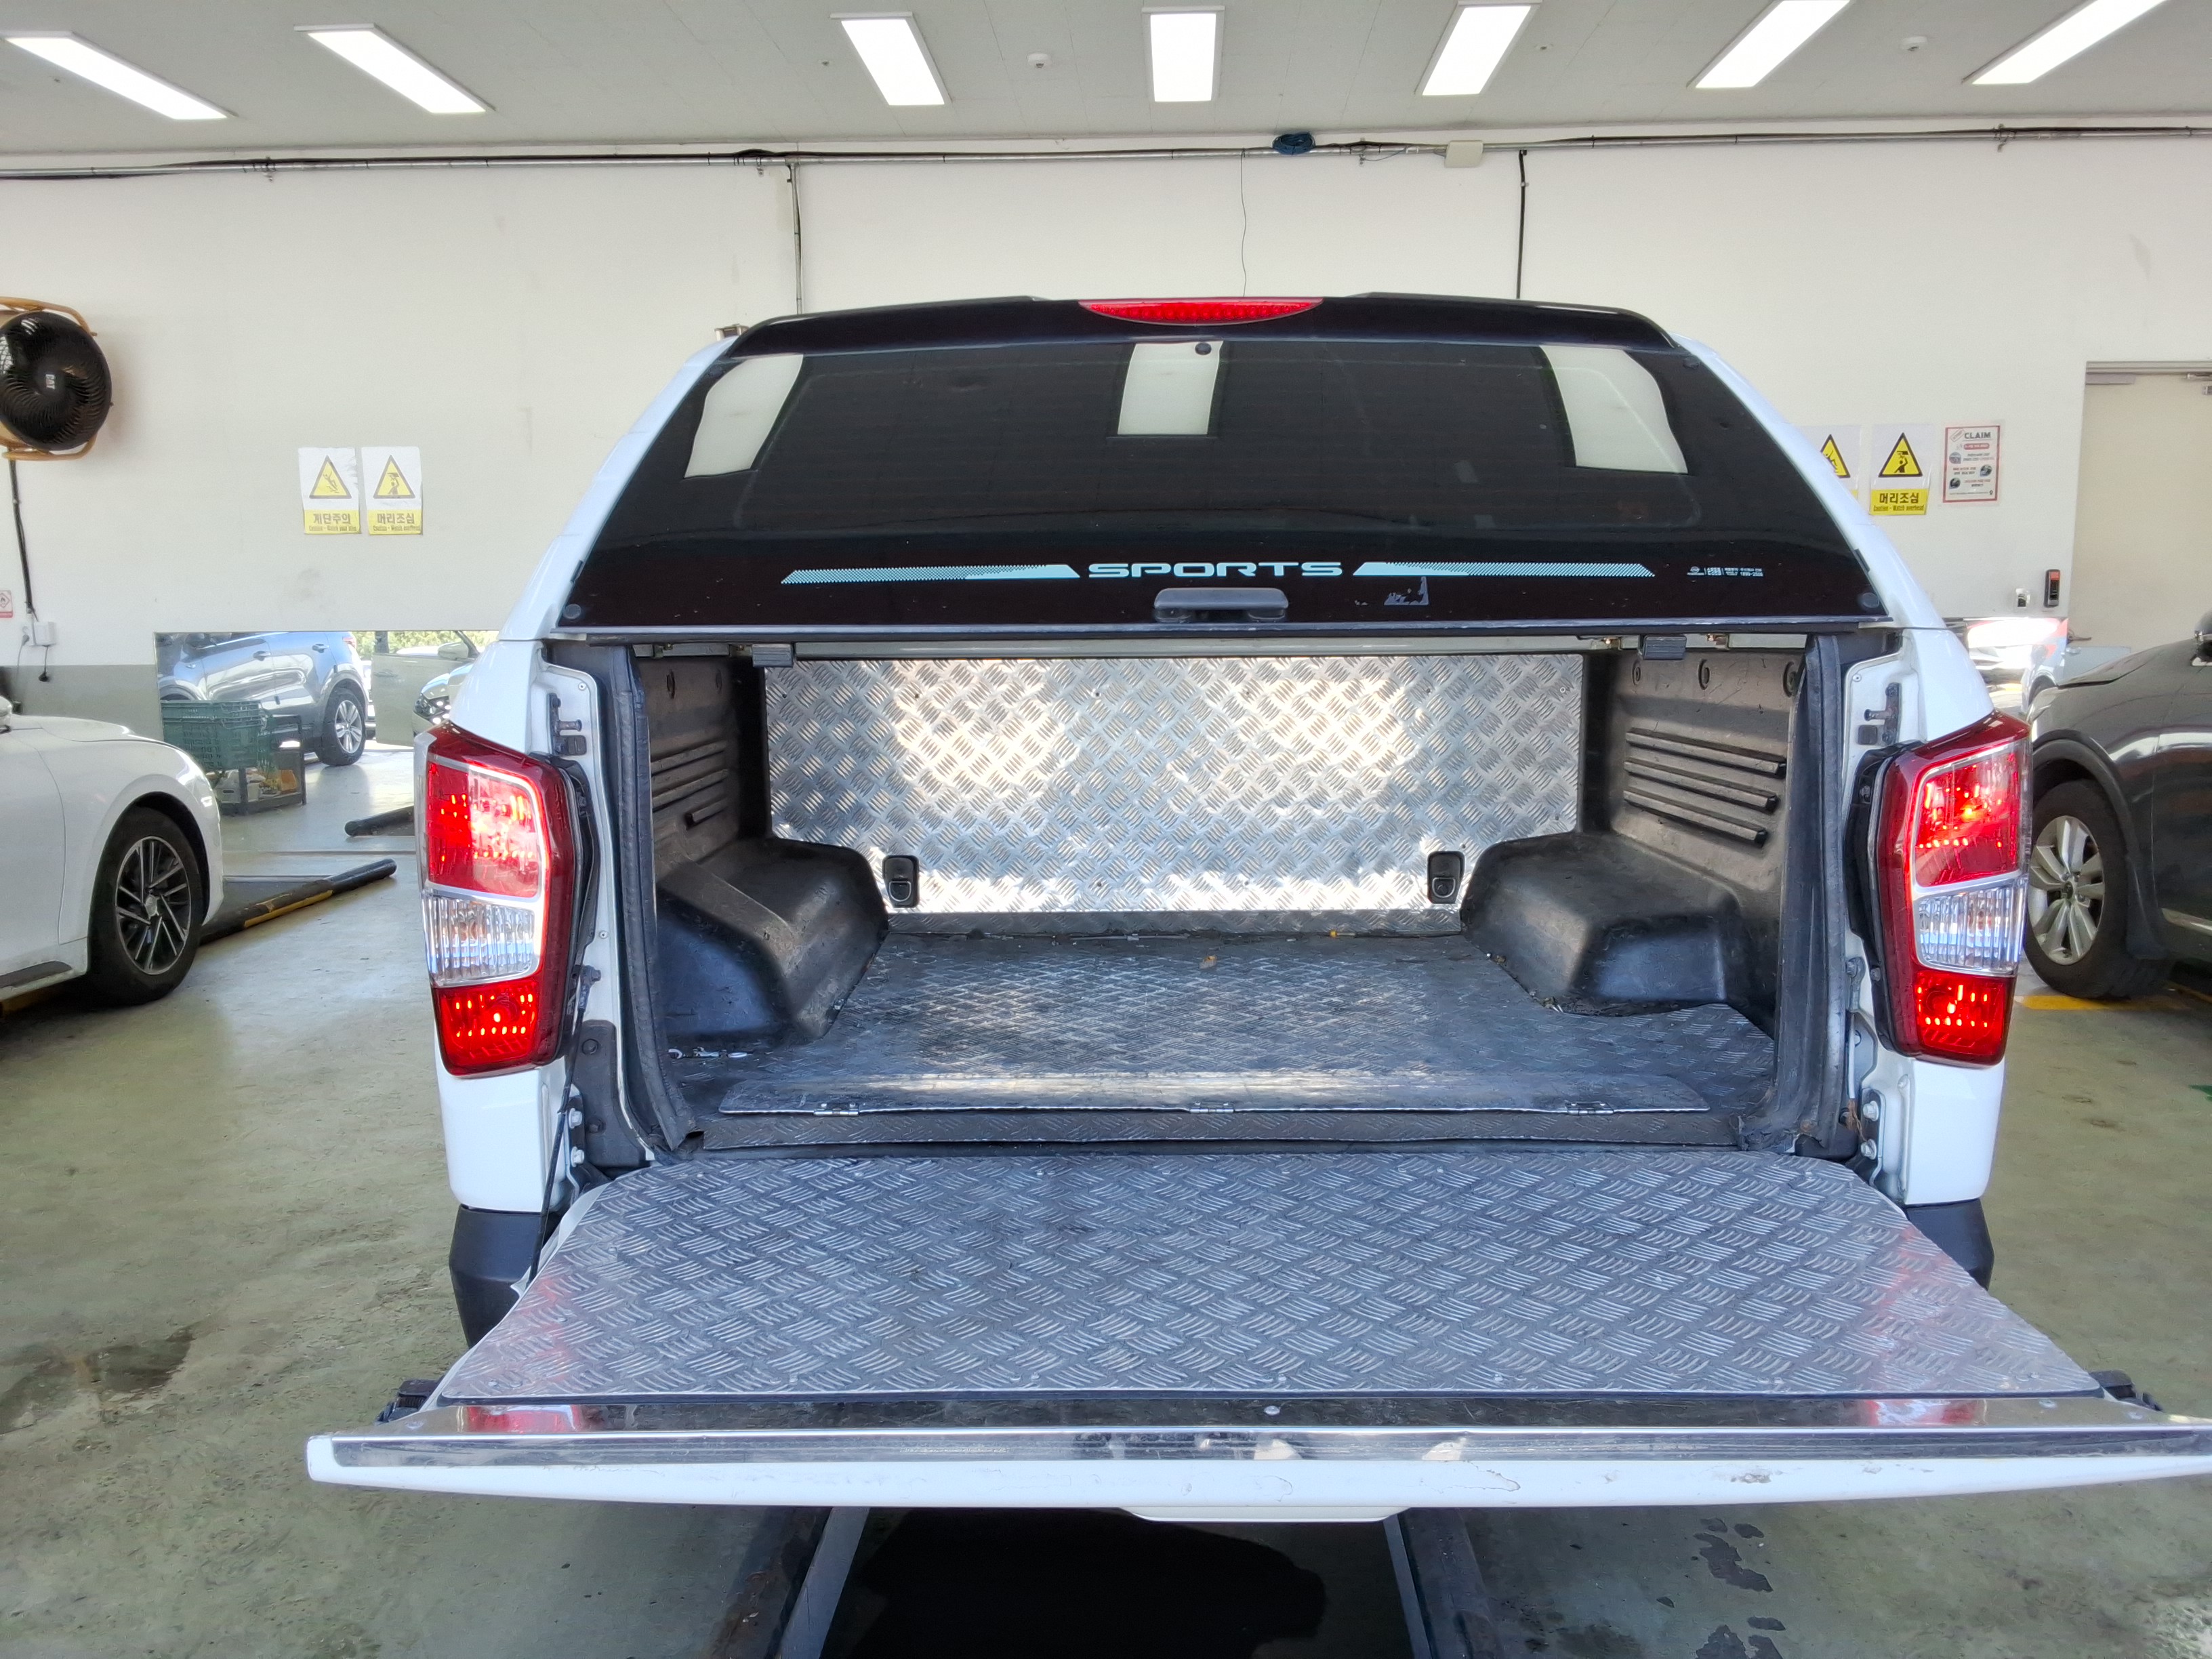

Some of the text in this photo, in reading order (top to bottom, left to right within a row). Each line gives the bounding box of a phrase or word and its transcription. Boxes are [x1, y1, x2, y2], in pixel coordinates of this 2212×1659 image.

[1879, 493, 1919, 504] 머리조심
[313, 513, 351, 525] 계단주의
[377, 513, 415, 525] 머리조심
[1088, 561, 1343, 578] SPORTS
